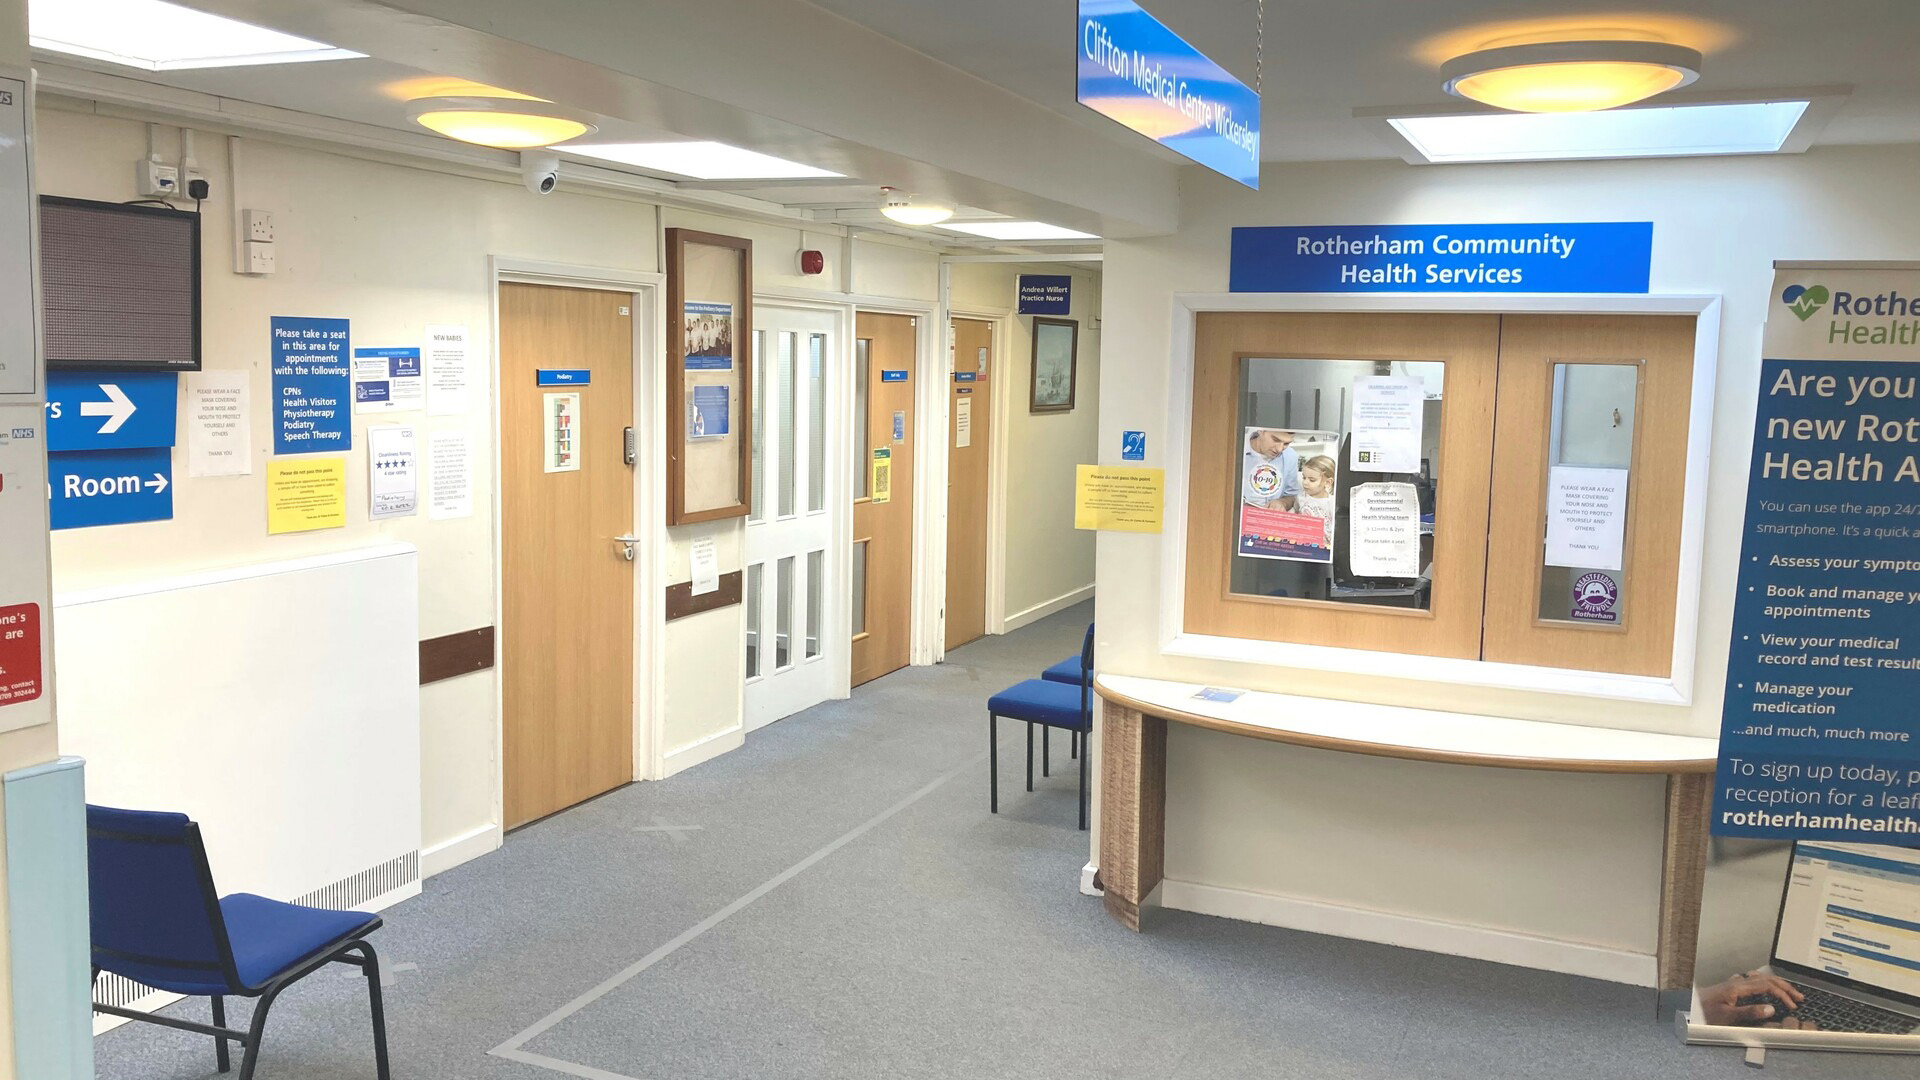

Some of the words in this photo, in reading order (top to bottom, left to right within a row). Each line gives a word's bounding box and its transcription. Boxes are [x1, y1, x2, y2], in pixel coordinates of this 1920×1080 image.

[1085, 20, 1129, 80] Clifton
[1134, 50, 1176, 109] Medical
[1179, 82, 1211, 129] Centre
[1214, 103, 1257, 161] Wickersley
[1297, 235, 1425, 256] Rotherham
[1432, 233, 1575, 258] Community
[1341, 264, 1417, 283] Health
[1426, 263, 1523, 284] Services
[1833, 291, 1920, 316] Rothe
[275, 329, 299, 338] Please
[303, 330, 320, 338] take
[330, 331, 346, 339] seat
[283, 341, 289, 350] in
[293, 341, 306, 350] this
[329, 342, 340, 350] for
[286, 355, 337, 365] appointments
[275, 366, 292, 374] with
[312, 366, 348, 376] following:
[1770, 369, 1836, 397] Are
[1845, 375, 1915, 405] you
[283, 399, 307, 407] Health
[310, 398, 336, 406] Visitors
[284, 410, 334, 420] Physiotherapy
[284, 421, 314, 430] Podiatry
[1767, 416, 1845, 441] new
[1858, 414, 1920, 443] Rot
[13, 430, 33, 438] NHS
[284, 432, 309, 442] Speech
[312, 431, 341, 439] Therapy
[1763, 452, 1883, 482] Health
[1894, 456, 1920, 483] A
[64, 475, 140, 498] Room
[1760, 500, 1784, 512] You
[1789, 503, 1810, 513] can
[1815, 504, 1837, 513] use
[1841, 503, 1861, 513] the
[1865, 505, 1890, 516] app
[1757, 524, 1838, 536] smartphone.
[1843, 525, 1859, 536] It's
[1863, 527, 1870, 536] a
[1875, 527, 1909, 539] quick
[1770, 555, 1820, 567] Assess
[1824, 558, 1860, 570] your
[1863, 559, 1920, 573] sympto
[1575, 574, 1616, 591] BREASTFEEDING
[1767, 585, 1805, 598] Book
[1810, 587, 1837, 598] and
[1842, 589, 1904, 603] manage
[1581, 600, 1612, 612] FRIENDLY
[1764, 605, 1871, 619] appointments
[0, 612, 26, 624] ne's
[1575, 611, 1614, 620] Rotherham
[5, 630, 24, 640] are
[1761, 634, 1797, 646] View
[1800, 637, 1835, 649] your
[1839, 637, 1899, 650] medical
[1758, 654, 1807, 665] record
[1811, 655, 1839, 666] and
[1844, 656, 1872, 667] test
[11, 680, 34, 689] contact
[1755, 682, 1814, 697] Manage
[1818, 686, 1853, 698] your
[1753, 702, 1836, 714] medication
[1732, 725, 1772, 736] ...and
[1777, 726, 1820, 739] much,
[1825, 728, 1865, 739] much
[1870, 731, 1910, 742] more
[1730, 759, 1754, 775] To
[1761, 761, 1800, 782] sign
[1808, 766, 1832, 783] up
[1840, 765, 1900, 787] today,
[1726, 788, 1820, 807] reception
[1828, 788, 1856, 805] for
[1862, 794, 1873, 806] a
[1723, 810, 1920, 833] rotherhamhealth
